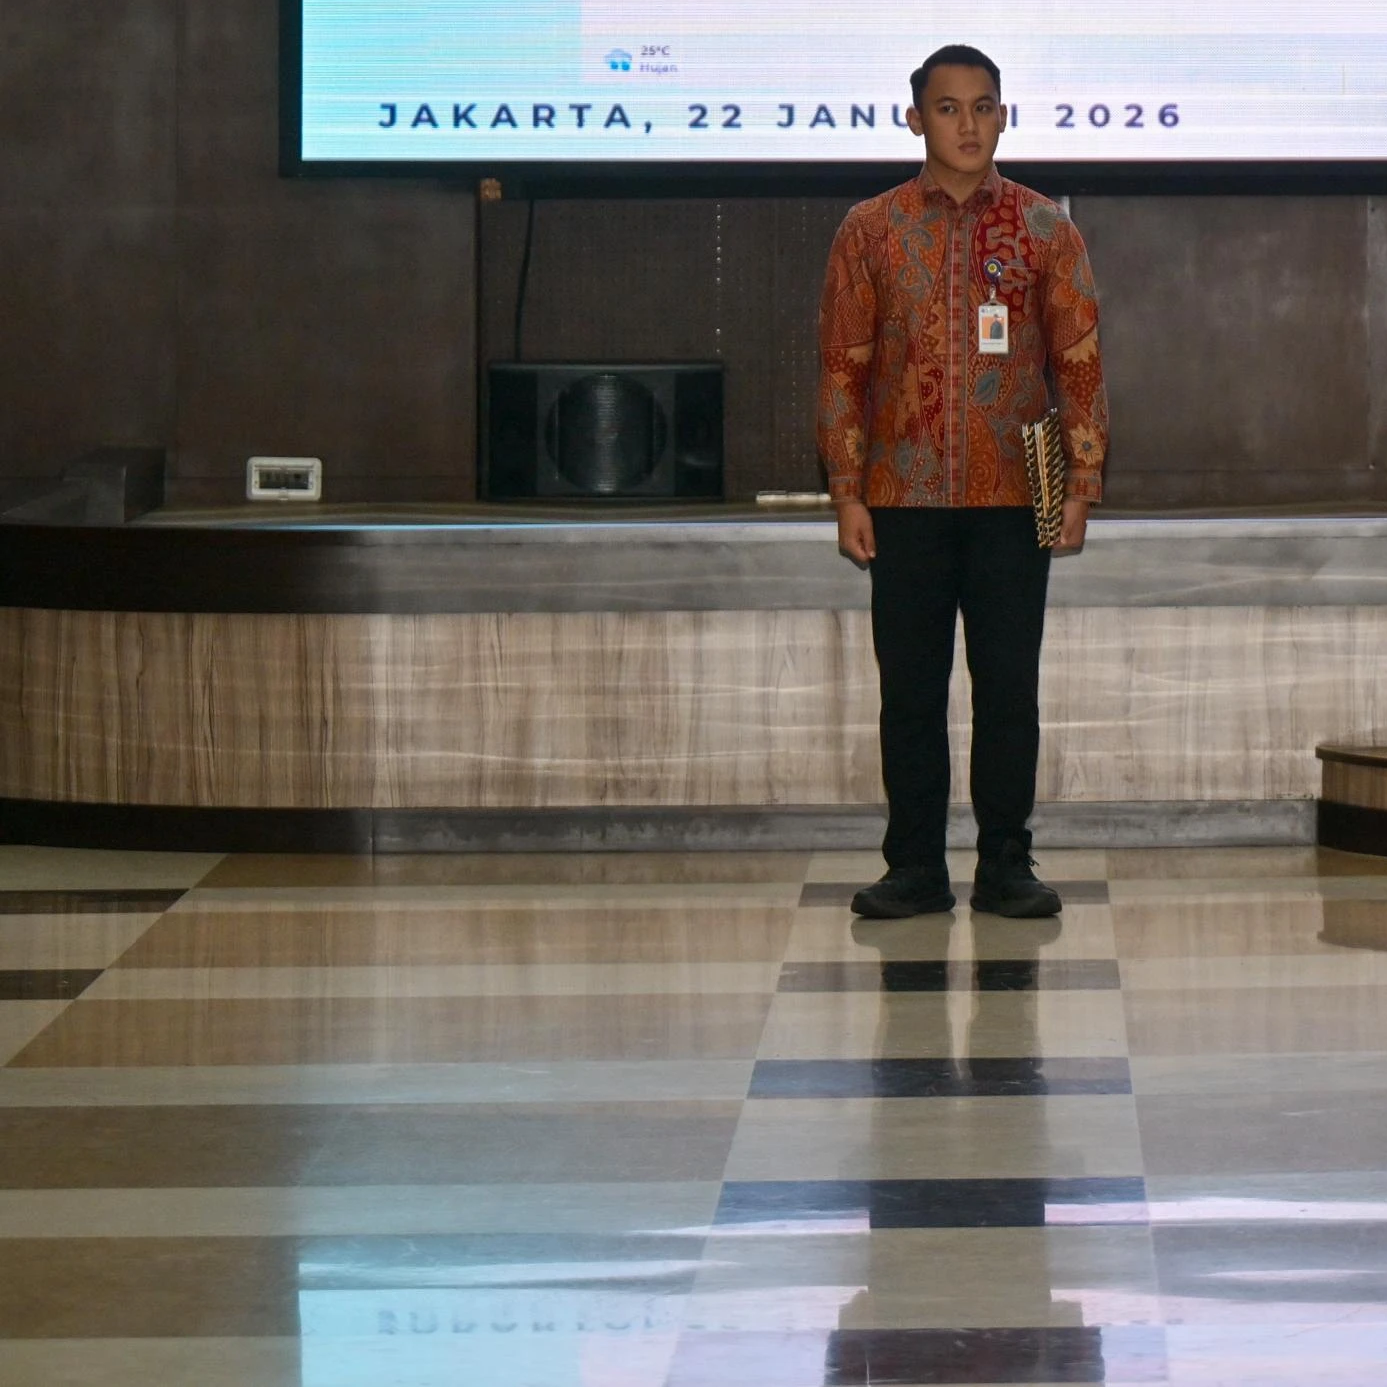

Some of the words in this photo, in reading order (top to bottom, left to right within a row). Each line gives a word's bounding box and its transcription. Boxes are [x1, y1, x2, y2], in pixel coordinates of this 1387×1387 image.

[378, 102, 653, 133] JAKARTA,
[687, 103, 743, 129] 22
[776, 103, 1018, 129] JANUI
[1054, 103, 1180, 129] 2026
